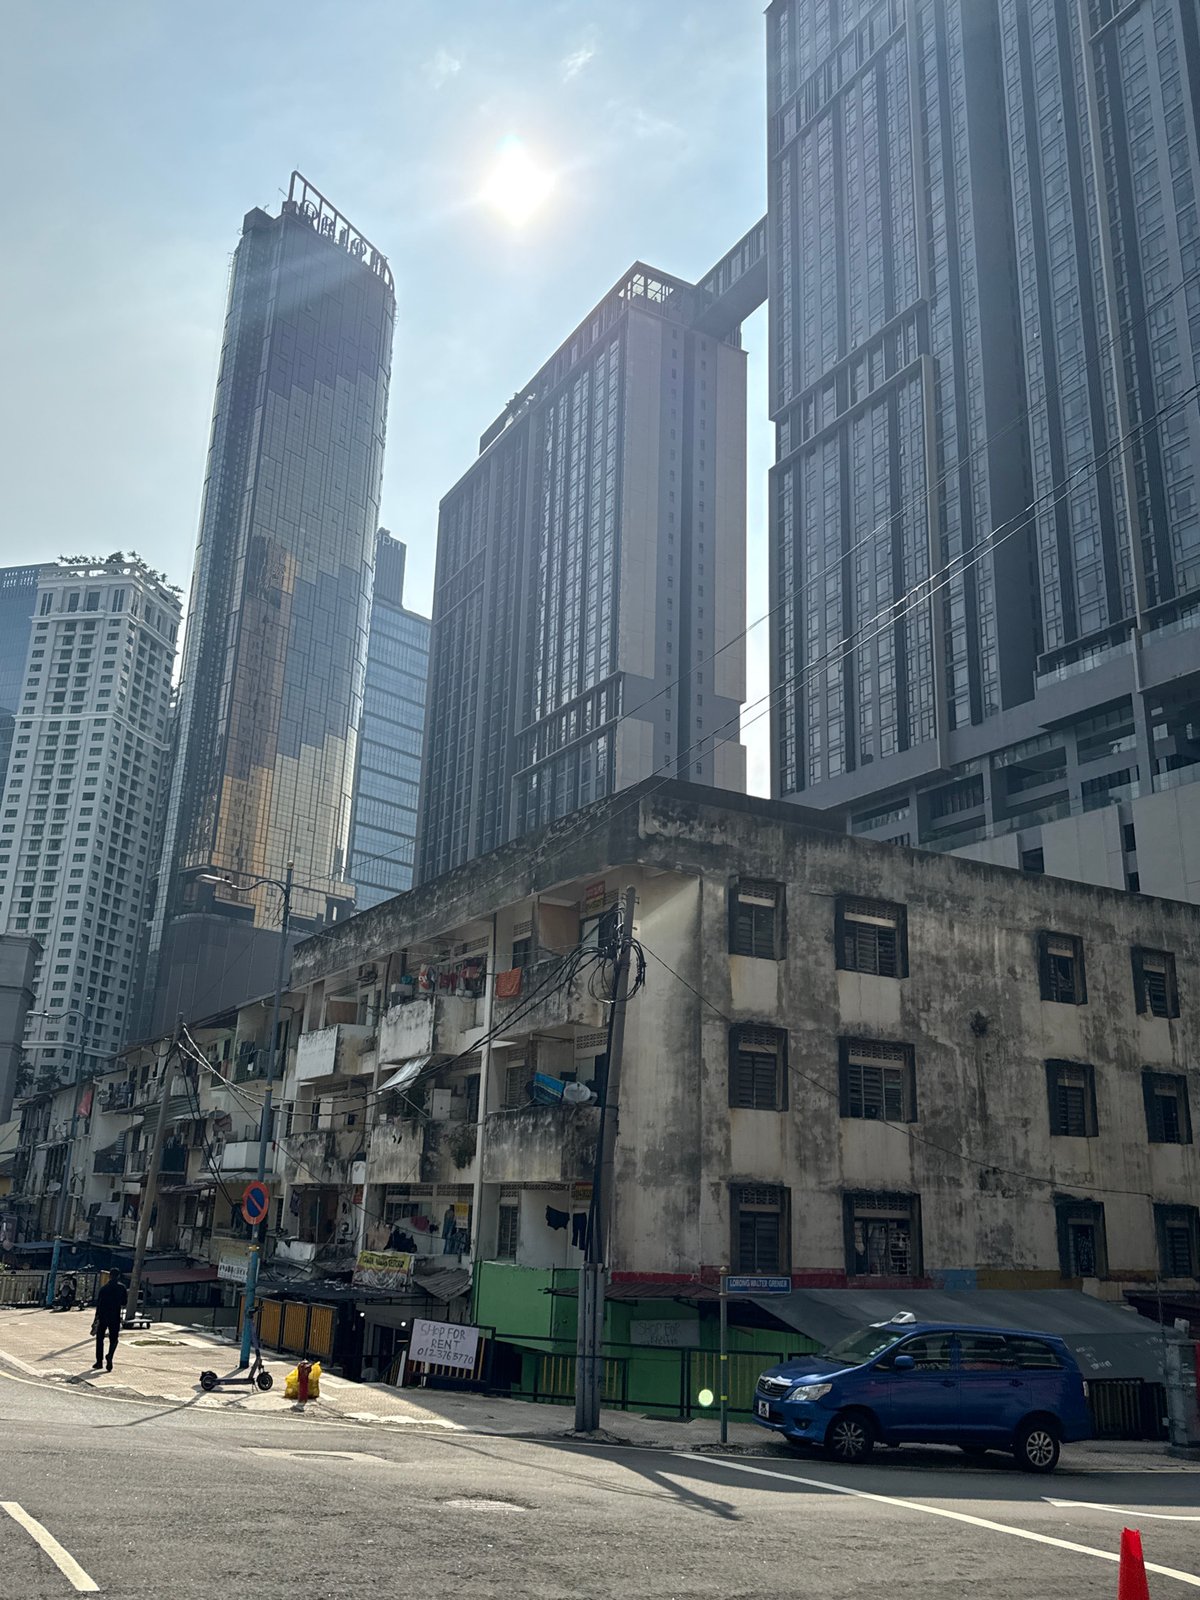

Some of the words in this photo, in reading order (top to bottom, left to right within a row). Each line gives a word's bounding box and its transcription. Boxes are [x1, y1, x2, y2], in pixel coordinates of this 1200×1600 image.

[730, 1279, 750, 1288] LORONG
[750, 1279, 768, 1288] WALTER
[768, 1279, 788, 1289] GRENIER
[420, 1322, 446, 1339] SHOP
[447, 1327, 467, 1340] FOR
[430, 1338, 461, 1351] RENT
